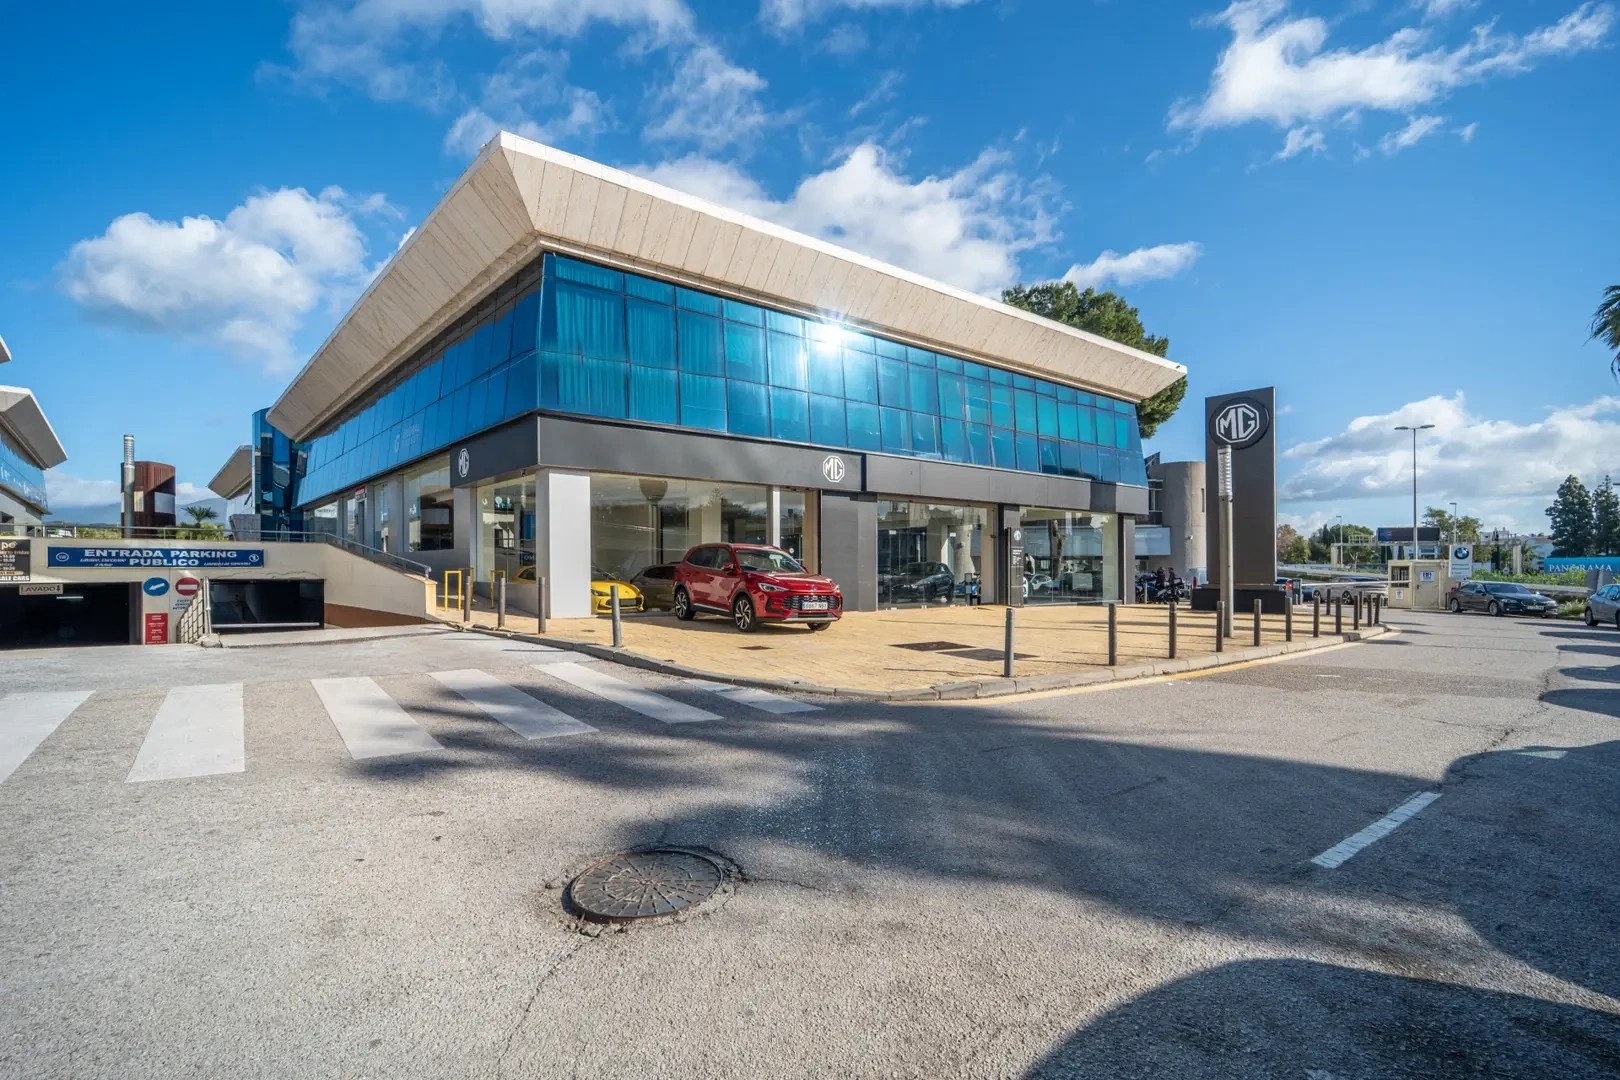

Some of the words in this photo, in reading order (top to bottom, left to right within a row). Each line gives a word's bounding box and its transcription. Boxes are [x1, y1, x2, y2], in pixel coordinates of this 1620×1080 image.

[1218, 405, 1257, 441] MG
[459, 449, 469, 477] MG
[824, 456, 844, 481] MG
[84, 549, 163, 557] ENTRADA
[170, 550, 237, 558] PARKING
